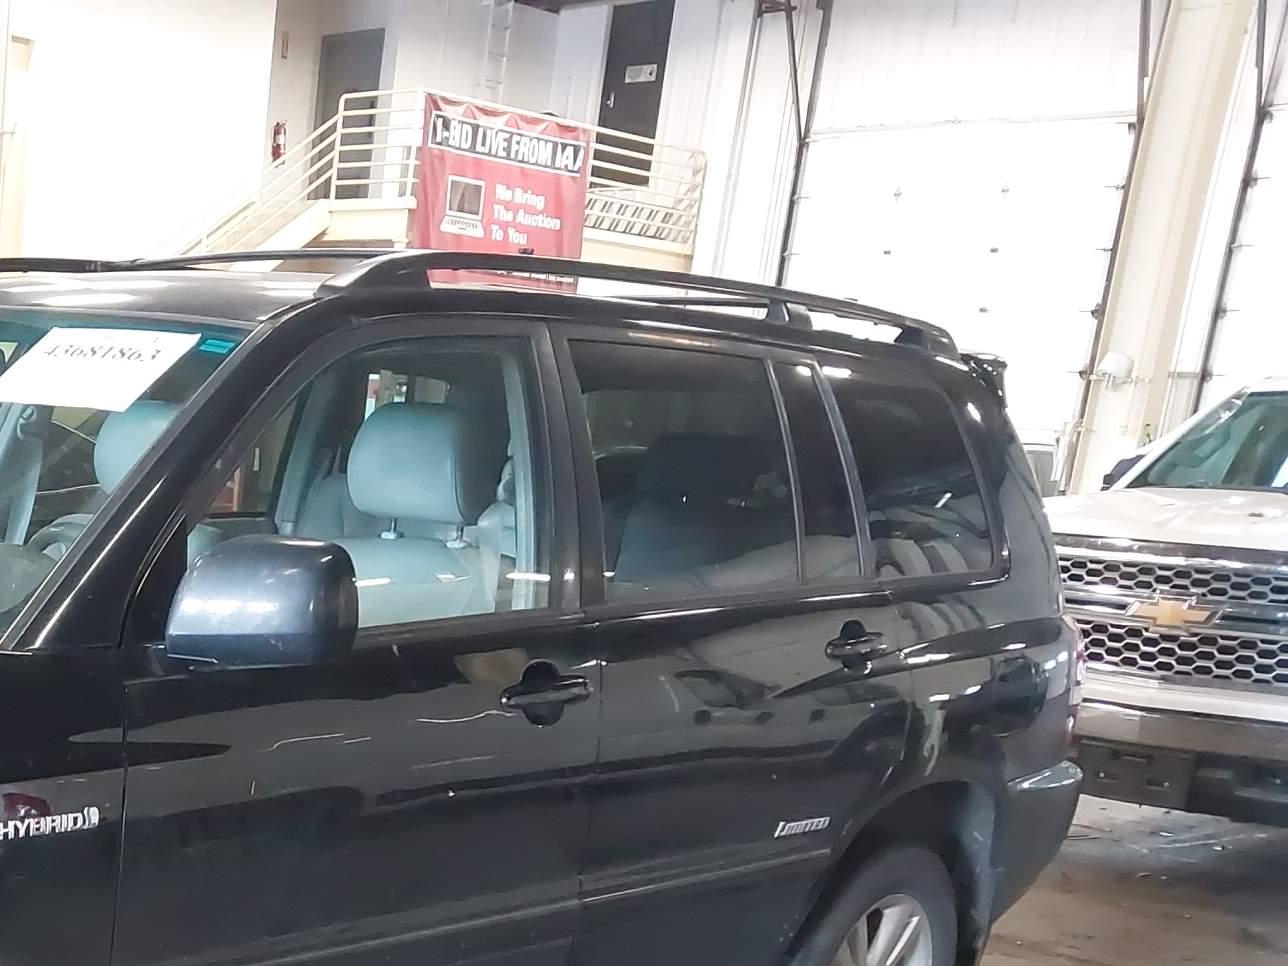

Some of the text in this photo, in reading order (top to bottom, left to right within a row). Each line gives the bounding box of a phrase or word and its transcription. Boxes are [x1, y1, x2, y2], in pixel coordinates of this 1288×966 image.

[475, 126, 509, 158] LIVE
[510, 133, 553, 167] FROM
[514, 187, 545, 211] Bring
[493, 204, 561, 230] The Auction
[490, 223, 528, 245] To You
